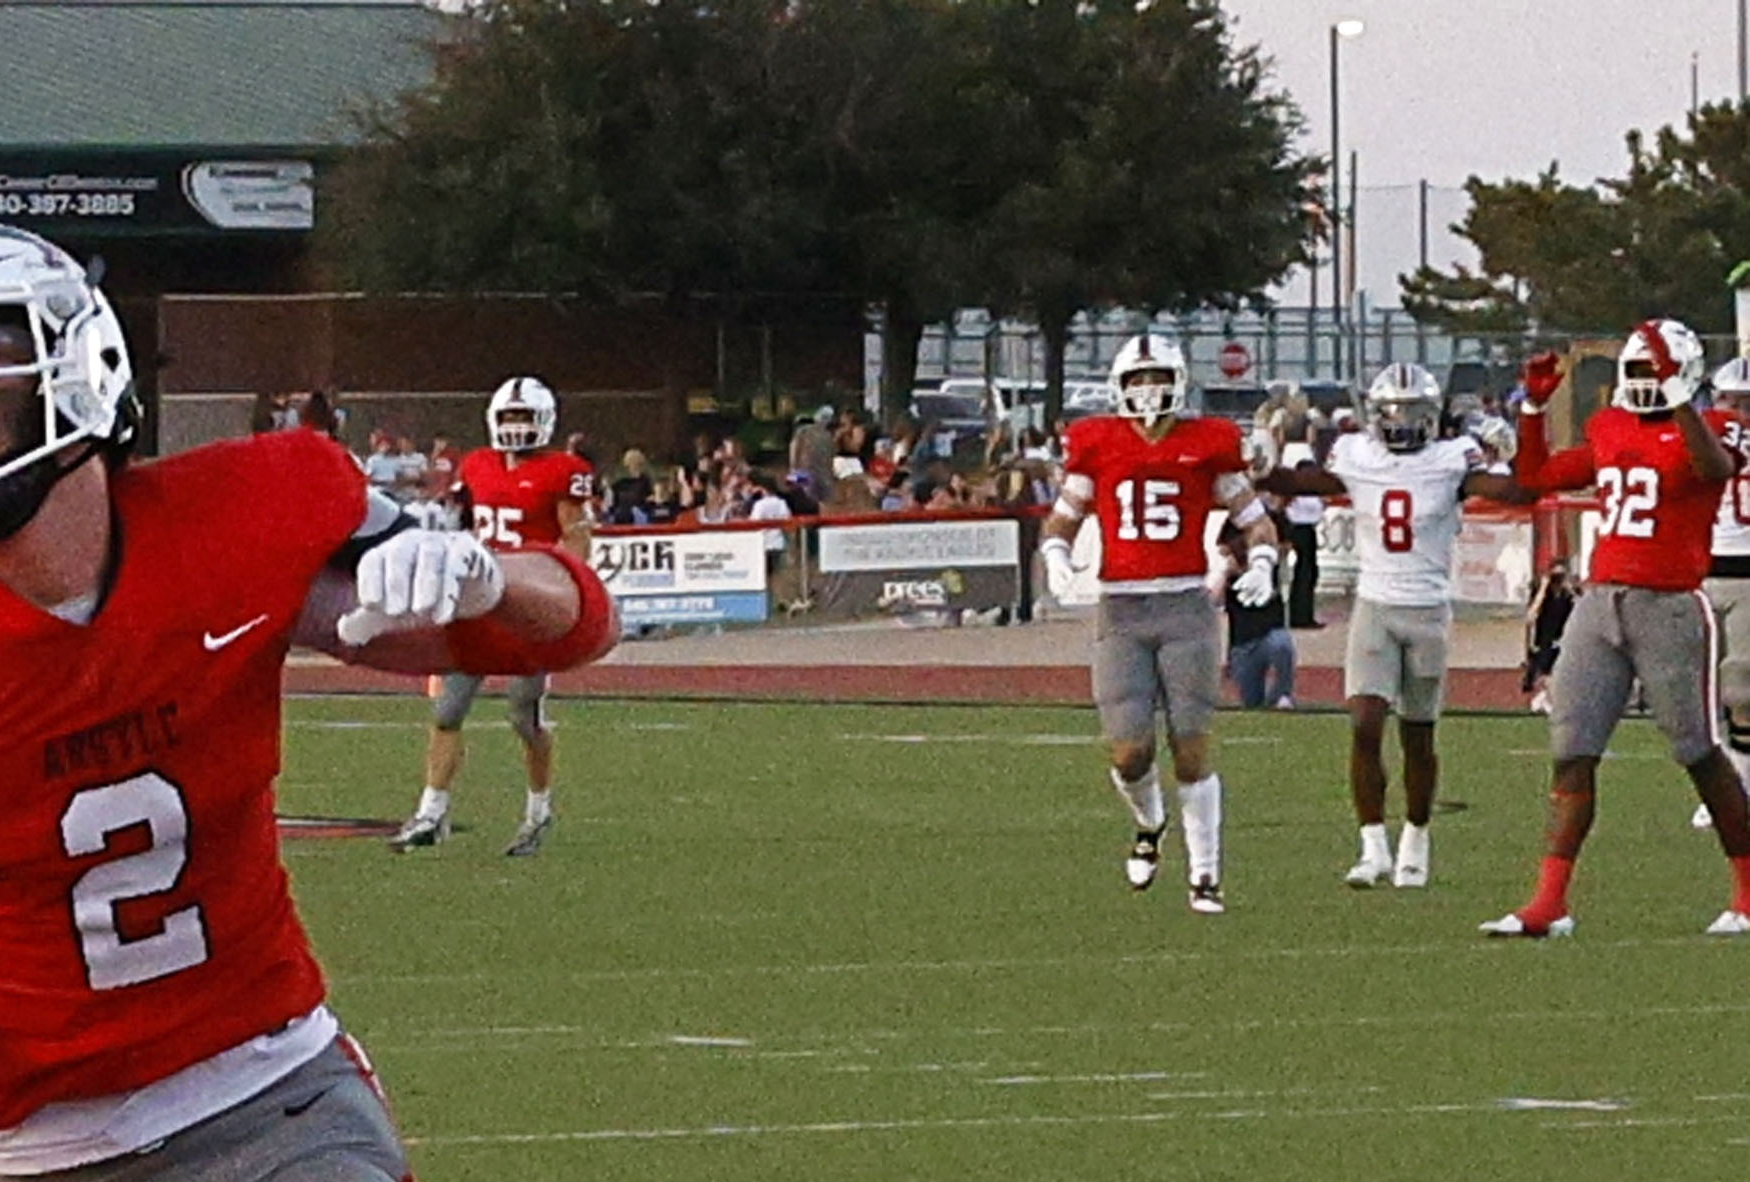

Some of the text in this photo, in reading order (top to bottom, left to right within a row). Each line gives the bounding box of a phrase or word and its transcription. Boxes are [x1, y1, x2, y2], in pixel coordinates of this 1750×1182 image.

[1115, 479, 1181, 541] 15
[1382, 489, 1413, 553] 8
[1597, 466, 1659, 538] 32
[60, 771, 209, 991] 2
